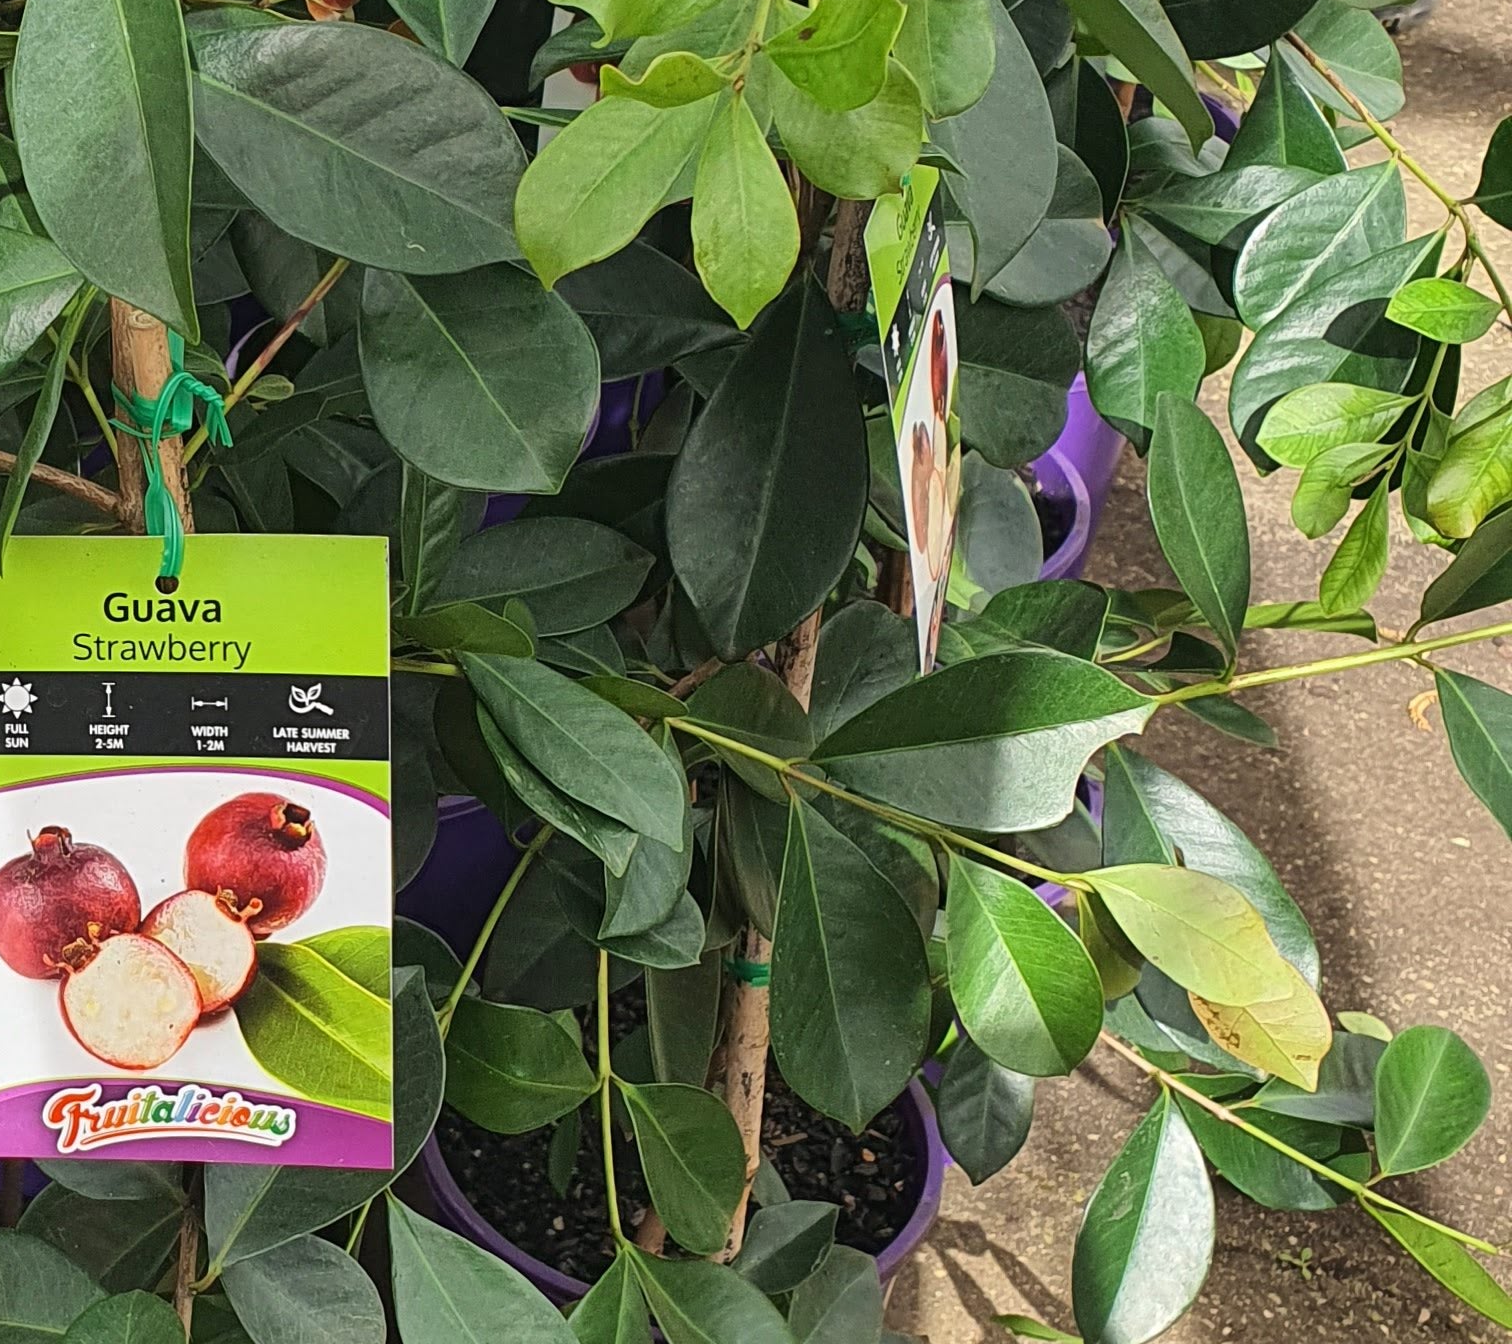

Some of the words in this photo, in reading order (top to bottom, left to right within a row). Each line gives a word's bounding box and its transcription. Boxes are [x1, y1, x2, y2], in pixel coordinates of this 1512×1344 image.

[103, 592, 222, 623] Guava
[73, 633, 252, 670] Strawberry
[4, 723, 29, 735] FULL
[89, 724, 130, 736] HEIGHT
[191, 726, 229, 738] WIDTH
[272, 727, 299, 739] LATE
[301, 728, 350, 740] SUMMER
[4, 737, 29, 749] SUN
[95, 738, 125, 750] 2-5M
[196, 739, 225, 751] 1-2M
[286, 742, 337, 754] HARVEST
[47, 1088, 292, 1148] Fruitalicious
